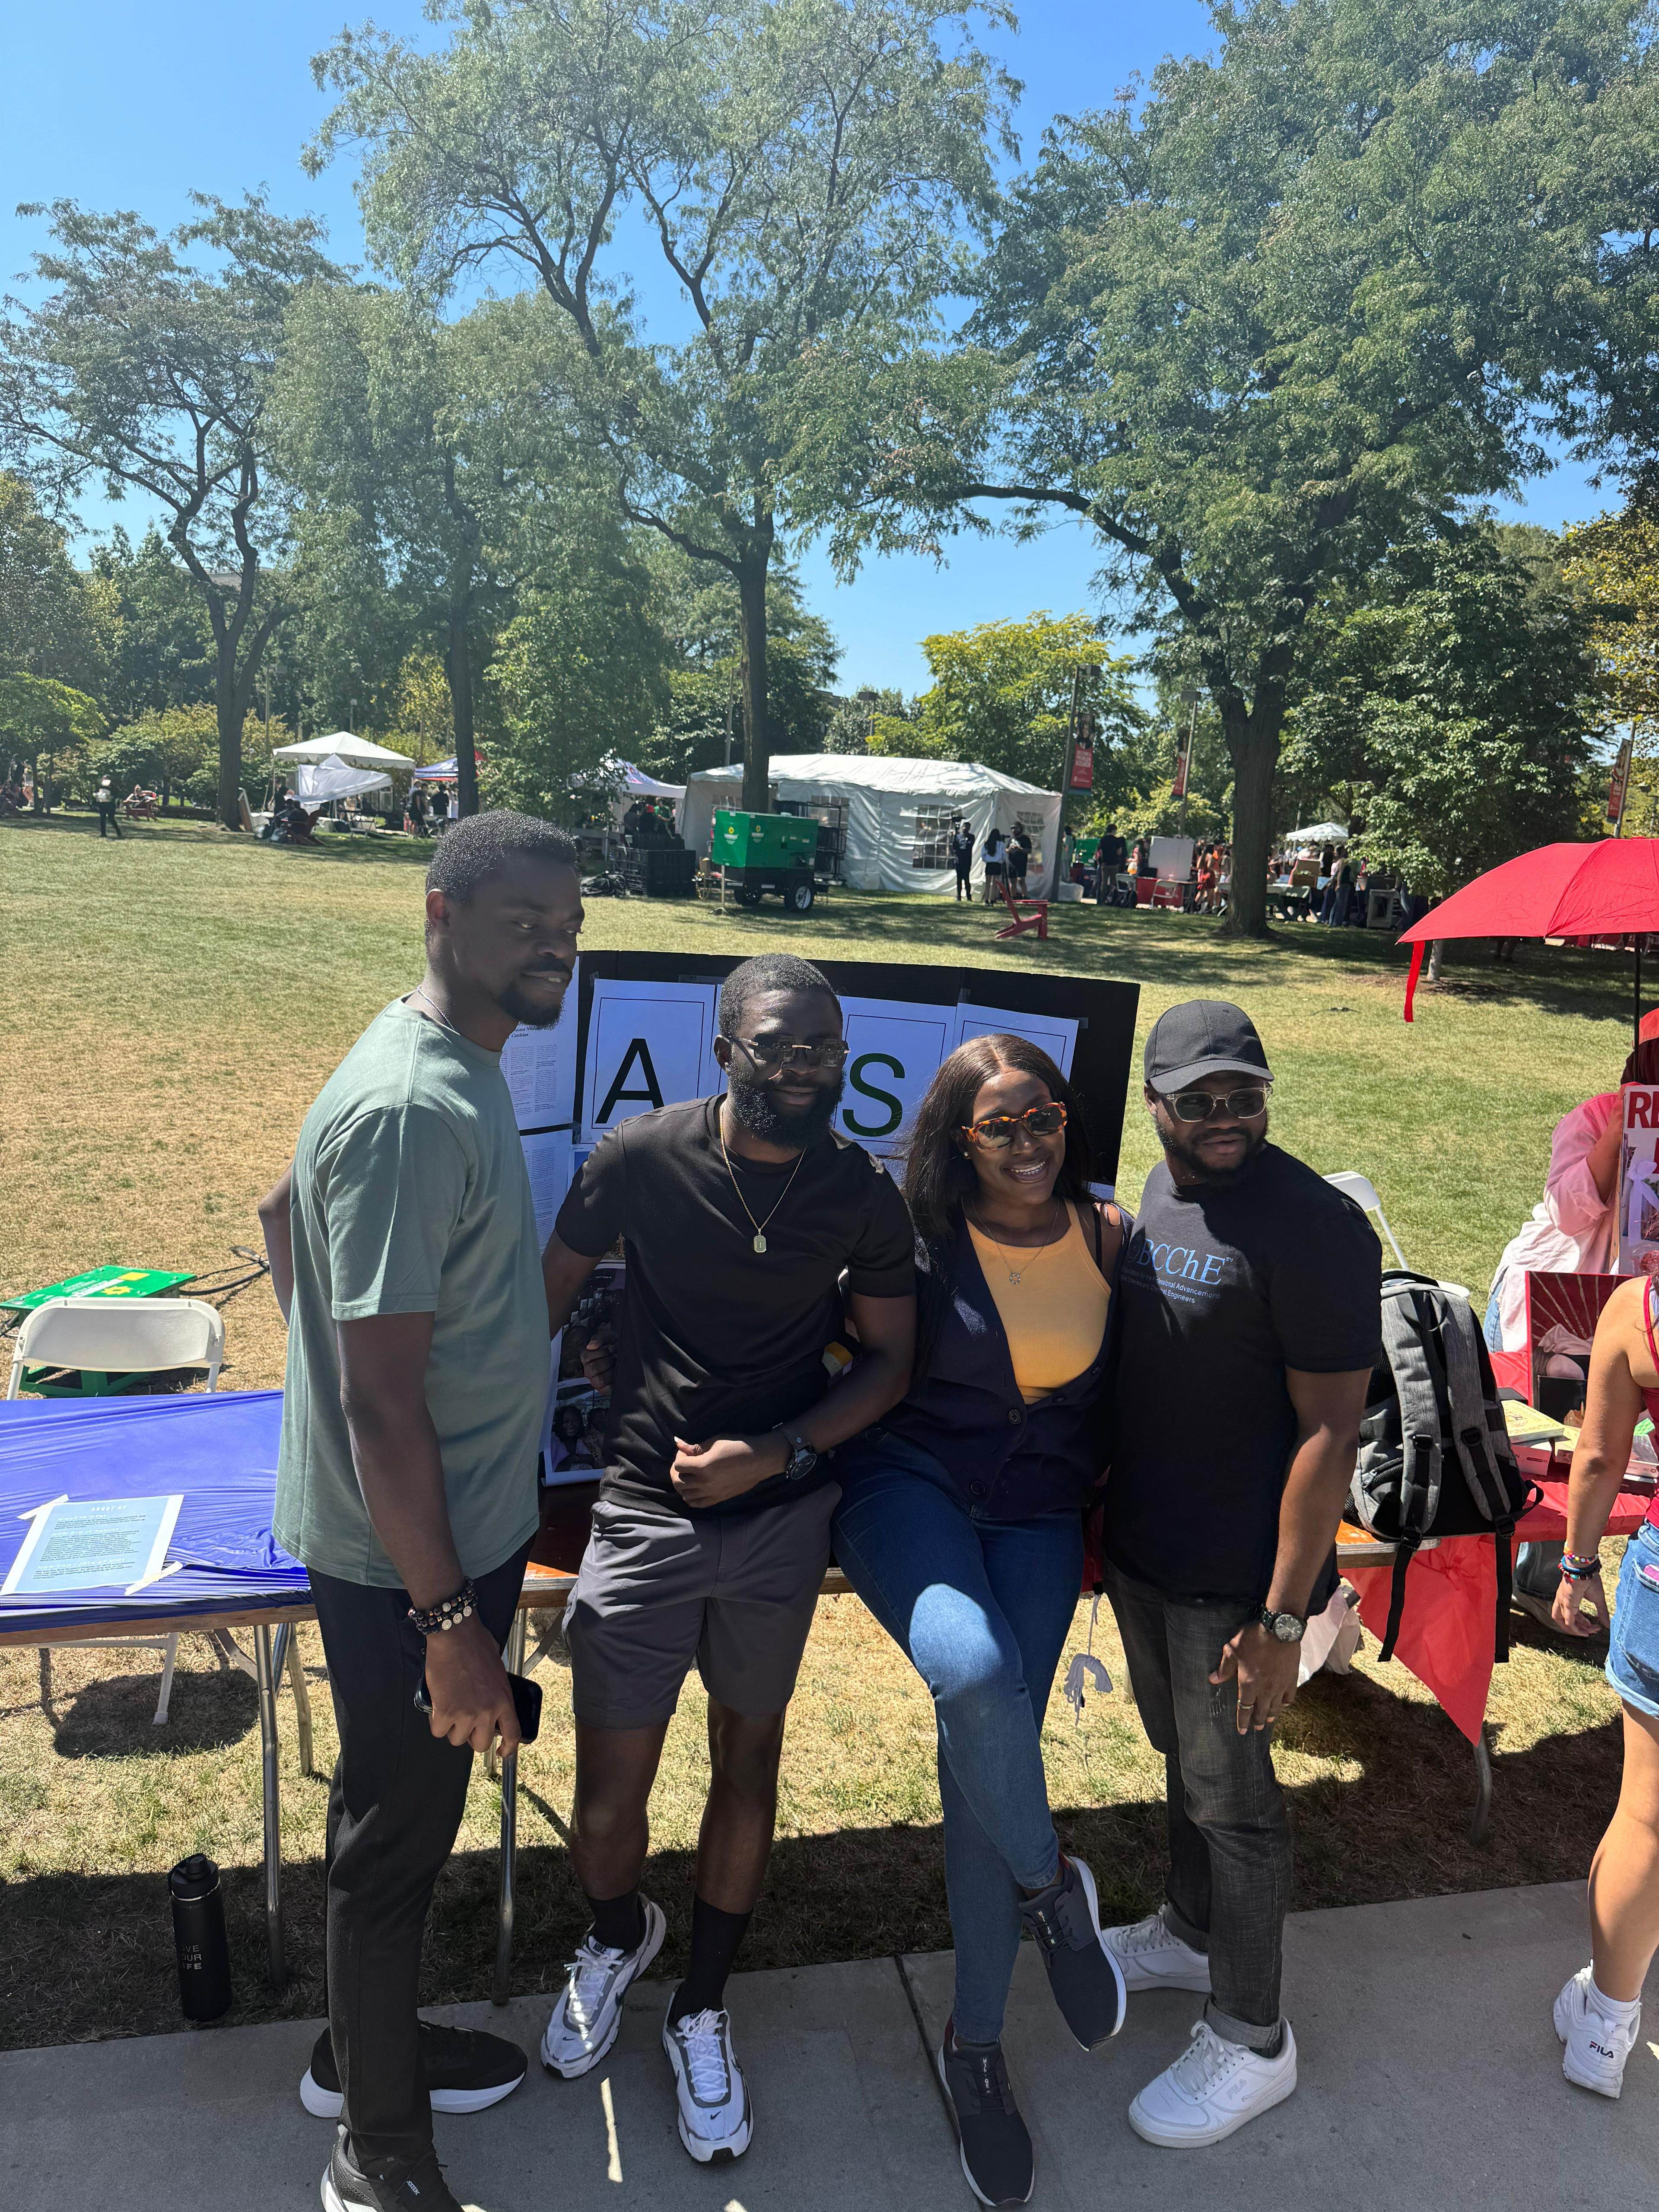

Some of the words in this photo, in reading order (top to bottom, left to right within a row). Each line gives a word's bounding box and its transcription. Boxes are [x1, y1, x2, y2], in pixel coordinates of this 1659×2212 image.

[595, 1038, 664, 1124] A
[842, 1052, 905, 1137] S
[1168, 1290, 1195, 1303] Engineers
[1176, 1283, 1221, 1300] Advancement
[593, 1942, 609, 1954] NIKE
[1589, 2040, 1614, 2059] FILA
[1226, 2079, 1247, 2101] FILA
